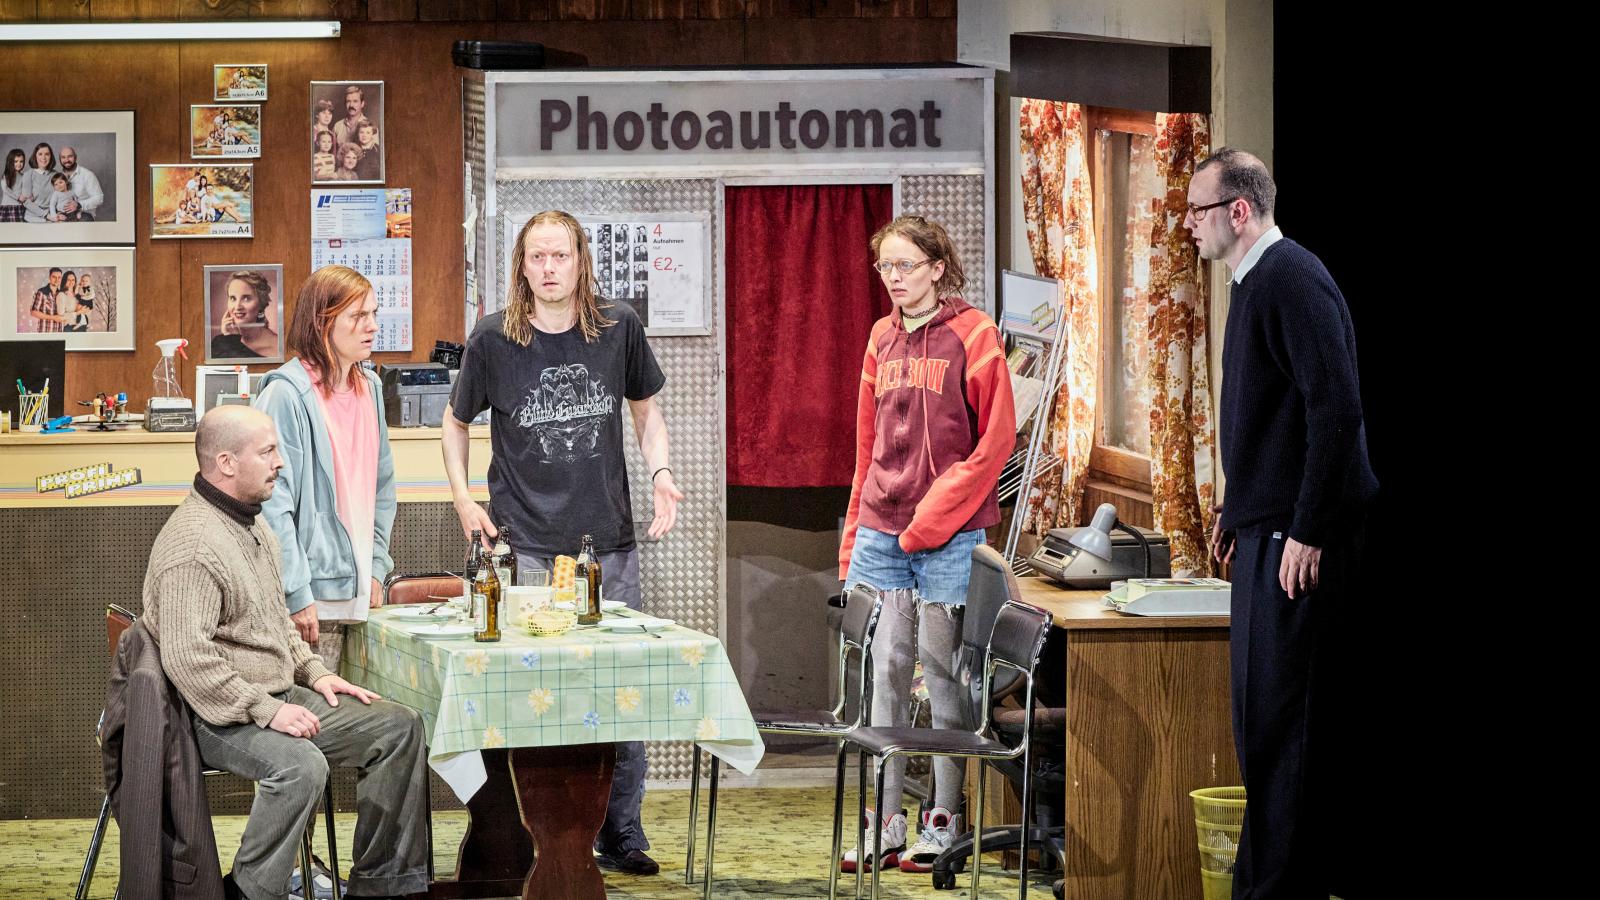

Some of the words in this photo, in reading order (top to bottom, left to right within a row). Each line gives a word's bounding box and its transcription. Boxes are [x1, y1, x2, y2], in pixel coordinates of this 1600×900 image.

[540, 95, 942, 151] Photoautomat
[247, 146, 258, 154] A5
[238, 225, 249, 234] A4
[653, 223, 663, 237] 4
[653, 256, 683, 273] €2,-
[519, 401, 555, 428] Blind
[556, 396, 614, 422] Guardian
[39, 465, 106, 489] PROFI
[66, 472, 133, 497] PRINT
